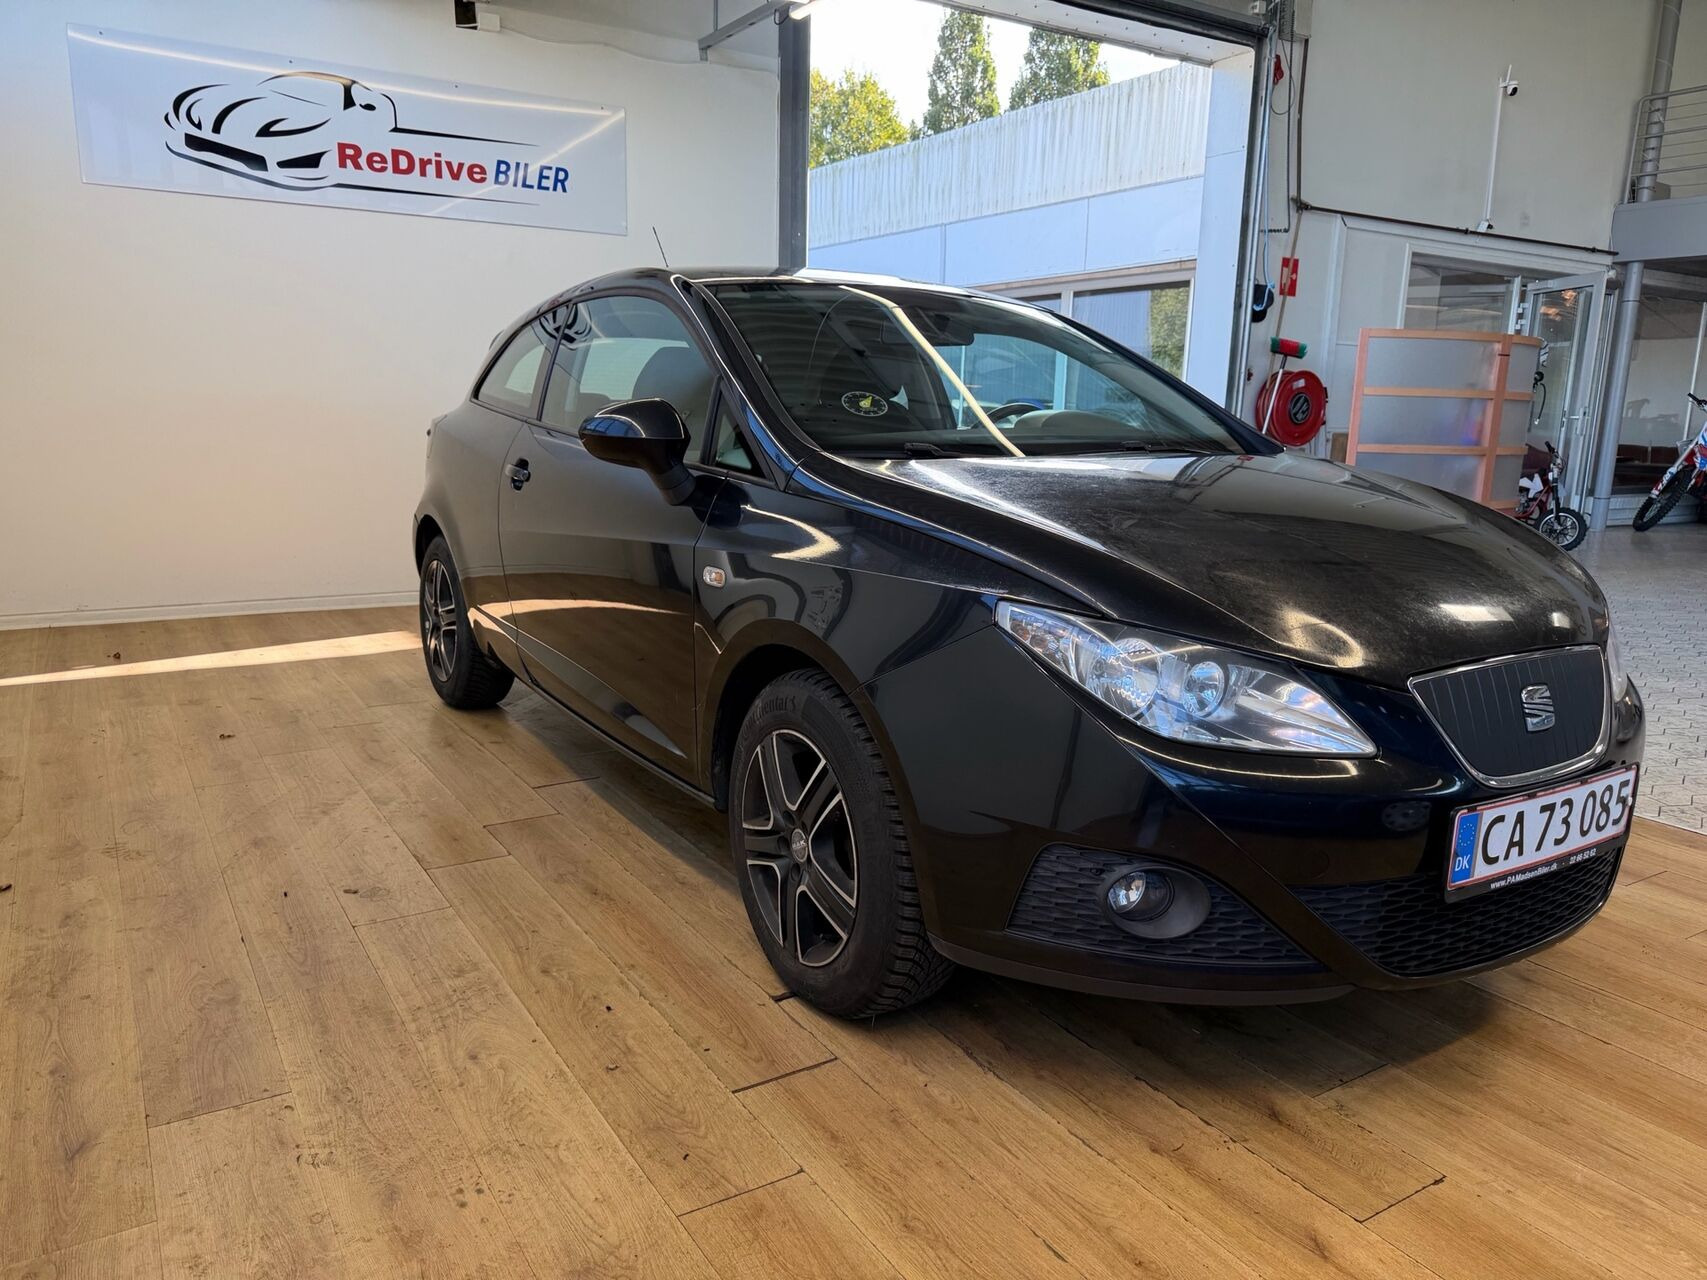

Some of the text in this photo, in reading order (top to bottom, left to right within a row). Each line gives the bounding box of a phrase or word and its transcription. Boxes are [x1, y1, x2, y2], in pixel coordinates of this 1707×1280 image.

[337, 142, 569, 193] ReDrive BILER
[1481, 779, 1631, 865] CA 73 085
[1454, 855, 1470, 872] DK
